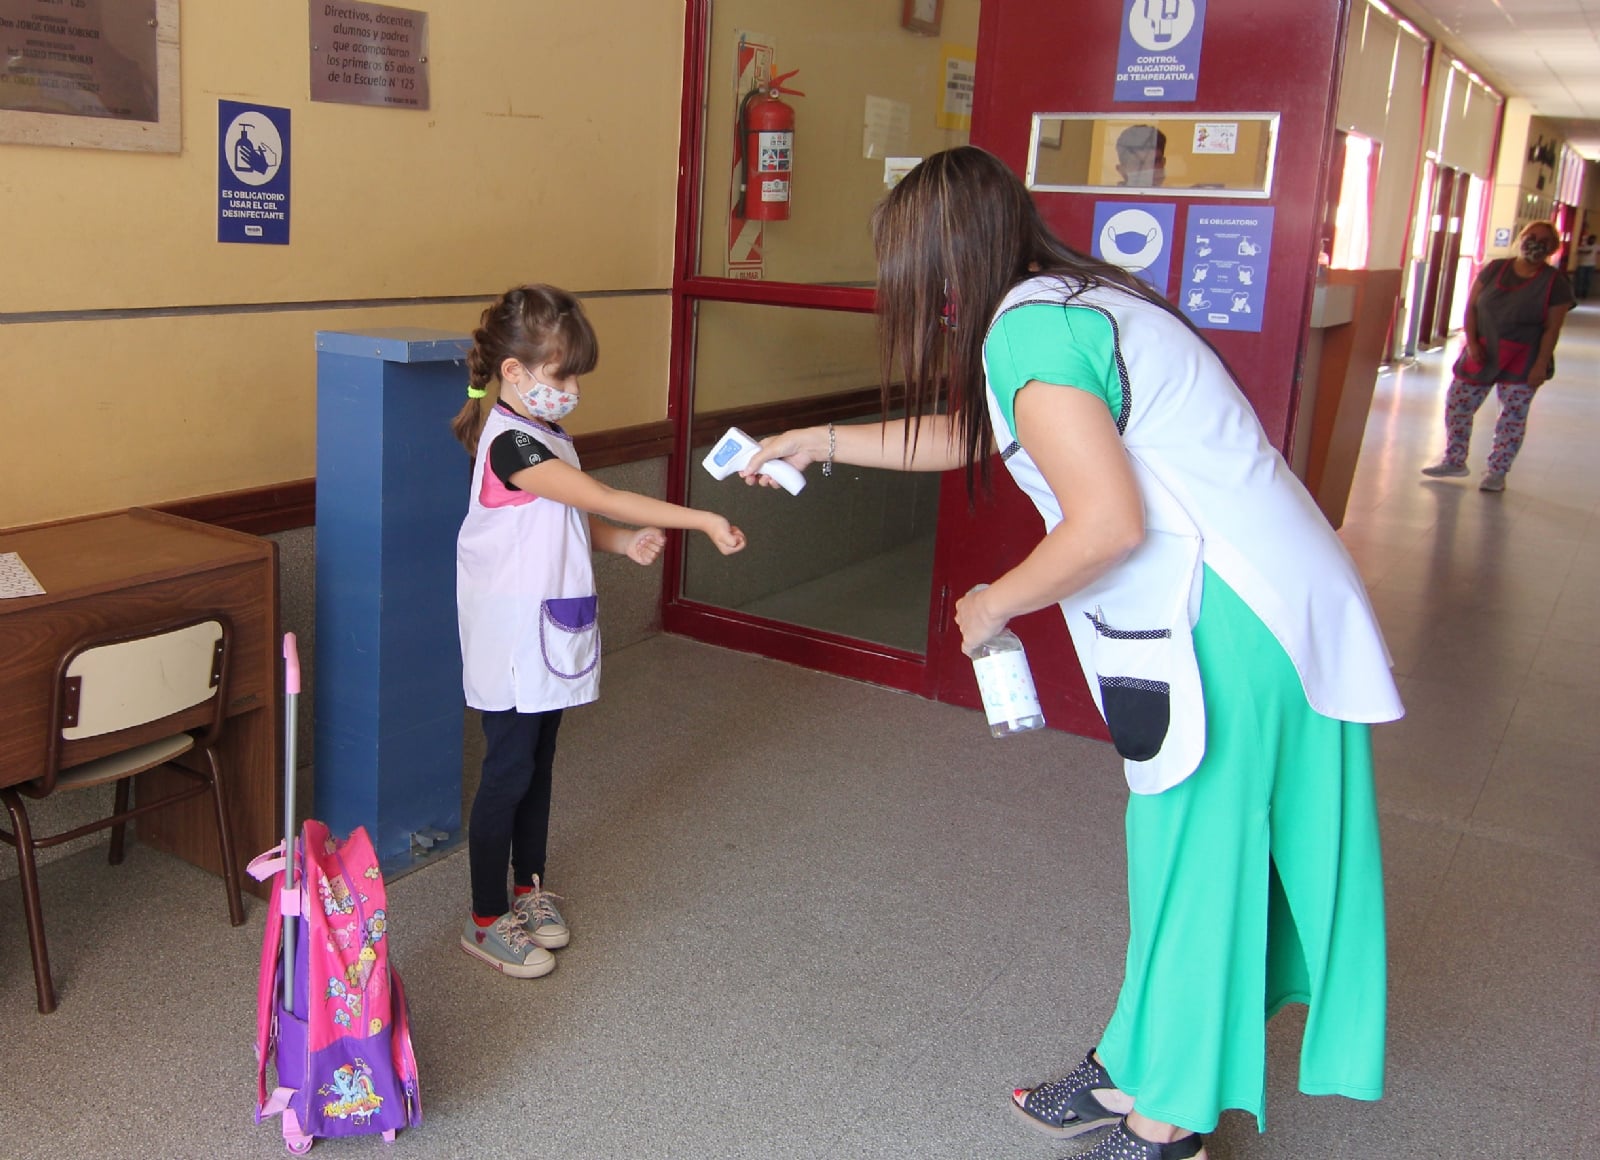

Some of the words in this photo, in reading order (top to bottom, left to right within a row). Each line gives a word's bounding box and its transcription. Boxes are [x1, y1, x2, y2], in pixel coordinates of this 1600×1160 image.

[324, 4, 372, 23] Directivos,
[333, 23, 370, 38] alumnos
[373, 31, 379, 40] y
[380, 31, 409, 43] padres
[333, 41, 350, 53] que
[342, 56, 382, 71] primeros
[384, 61, 395, 72] 65
[396, 63, 415, 74] años
[1136, 56, 1178, 64] CONTROL
[1127, 64, 1186, 73] OBLIGATORIO
[328, 71, 340, 82] de
[343, 72, 351, 83] la
[354, 73, 387, 87] Escuela
[401, 78, 415, 90] 125
[1116, 73, 1129, 81] DE
[1130, 73, 1195, 81] TEMPERATURA
[222, 189, 233, 198] ES
[233, 190, 285, 201] OBLIGATORIO
[230, 200, 252, 209] USAR
[252, 201, 262, 209] EL
[263, 202, 277, 210] GEL
[222, 209, 285, 220] DESINFECTANTE
[1209, 218, 1258, 226] OBLIGATORIO
